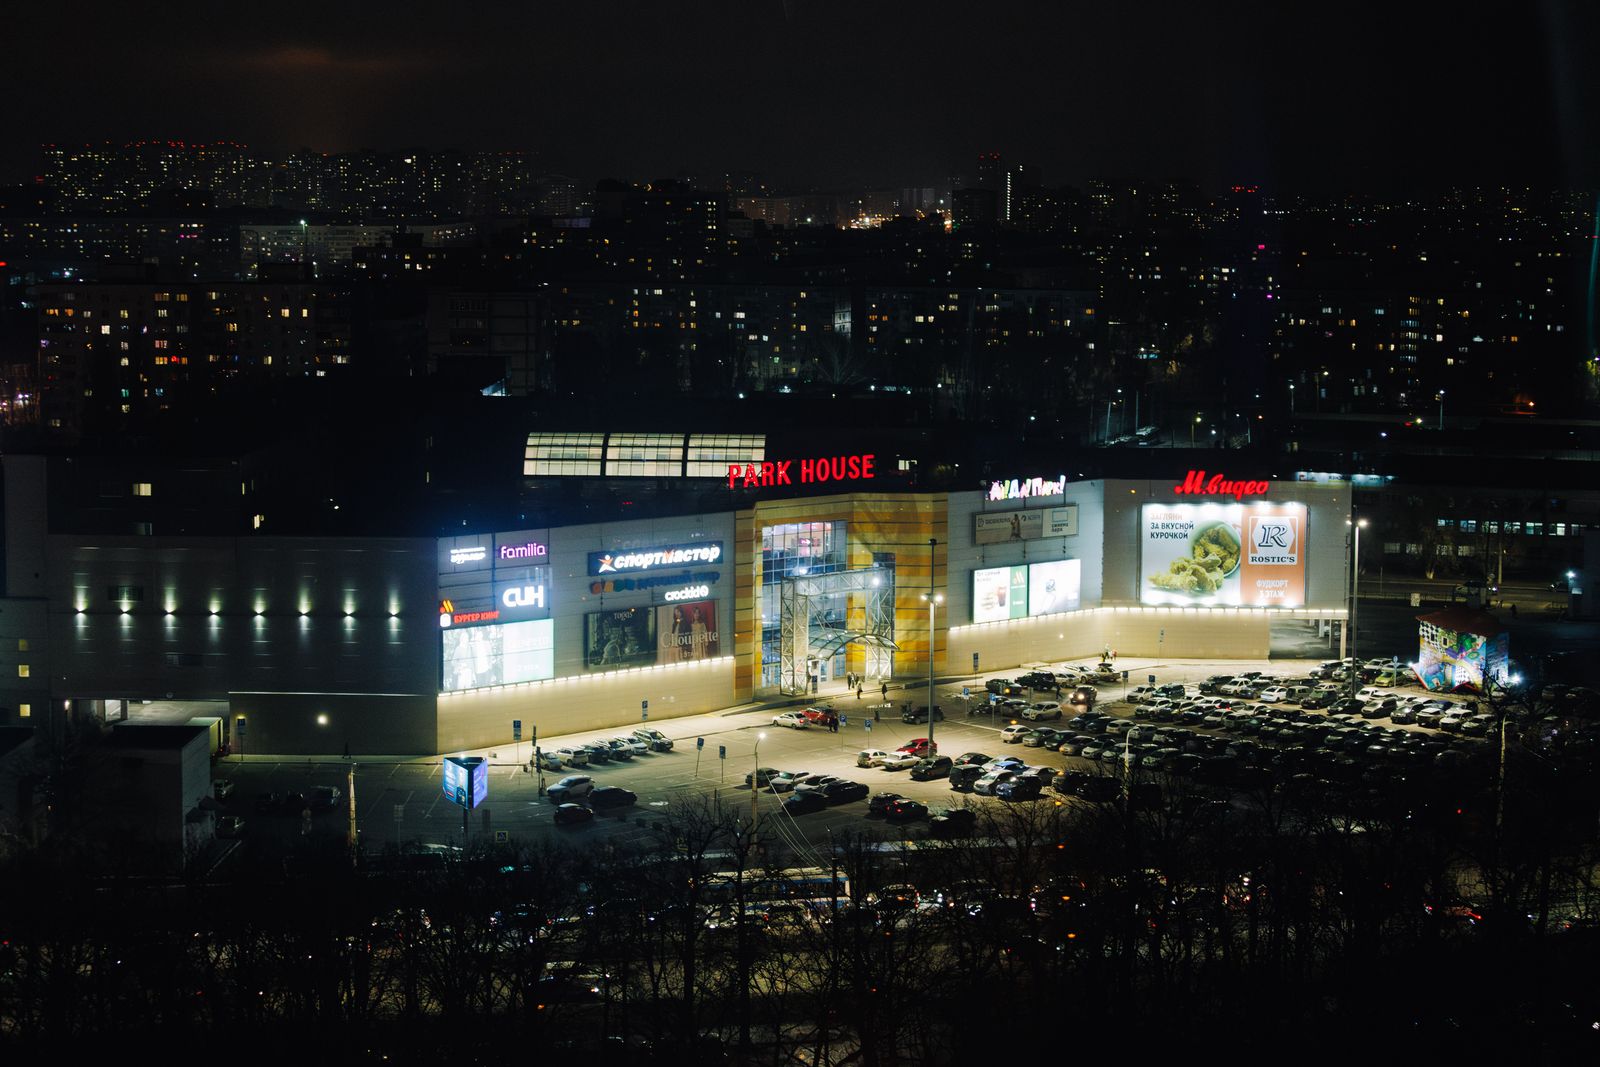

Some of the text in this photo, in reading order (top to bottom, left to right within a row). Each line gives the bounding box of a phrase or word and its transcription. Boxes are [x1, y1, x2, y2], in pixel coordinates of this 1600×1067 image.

[728, 454, 875, 489] PARK HOUSE
[1173, 470, 1270, 501] М.видео
[1150, 520, 1194, 530] ЗА ВКУСНОЙ
[1150, 530, 1189, 539] КУРОЧКОЙ
[1250, 556, 1296, 564] ROSTIC'S
[1256, 579, 1289, 588] ФУДКОРТ
[454, 610, 500, 624] БУРГЕР КИНГ
